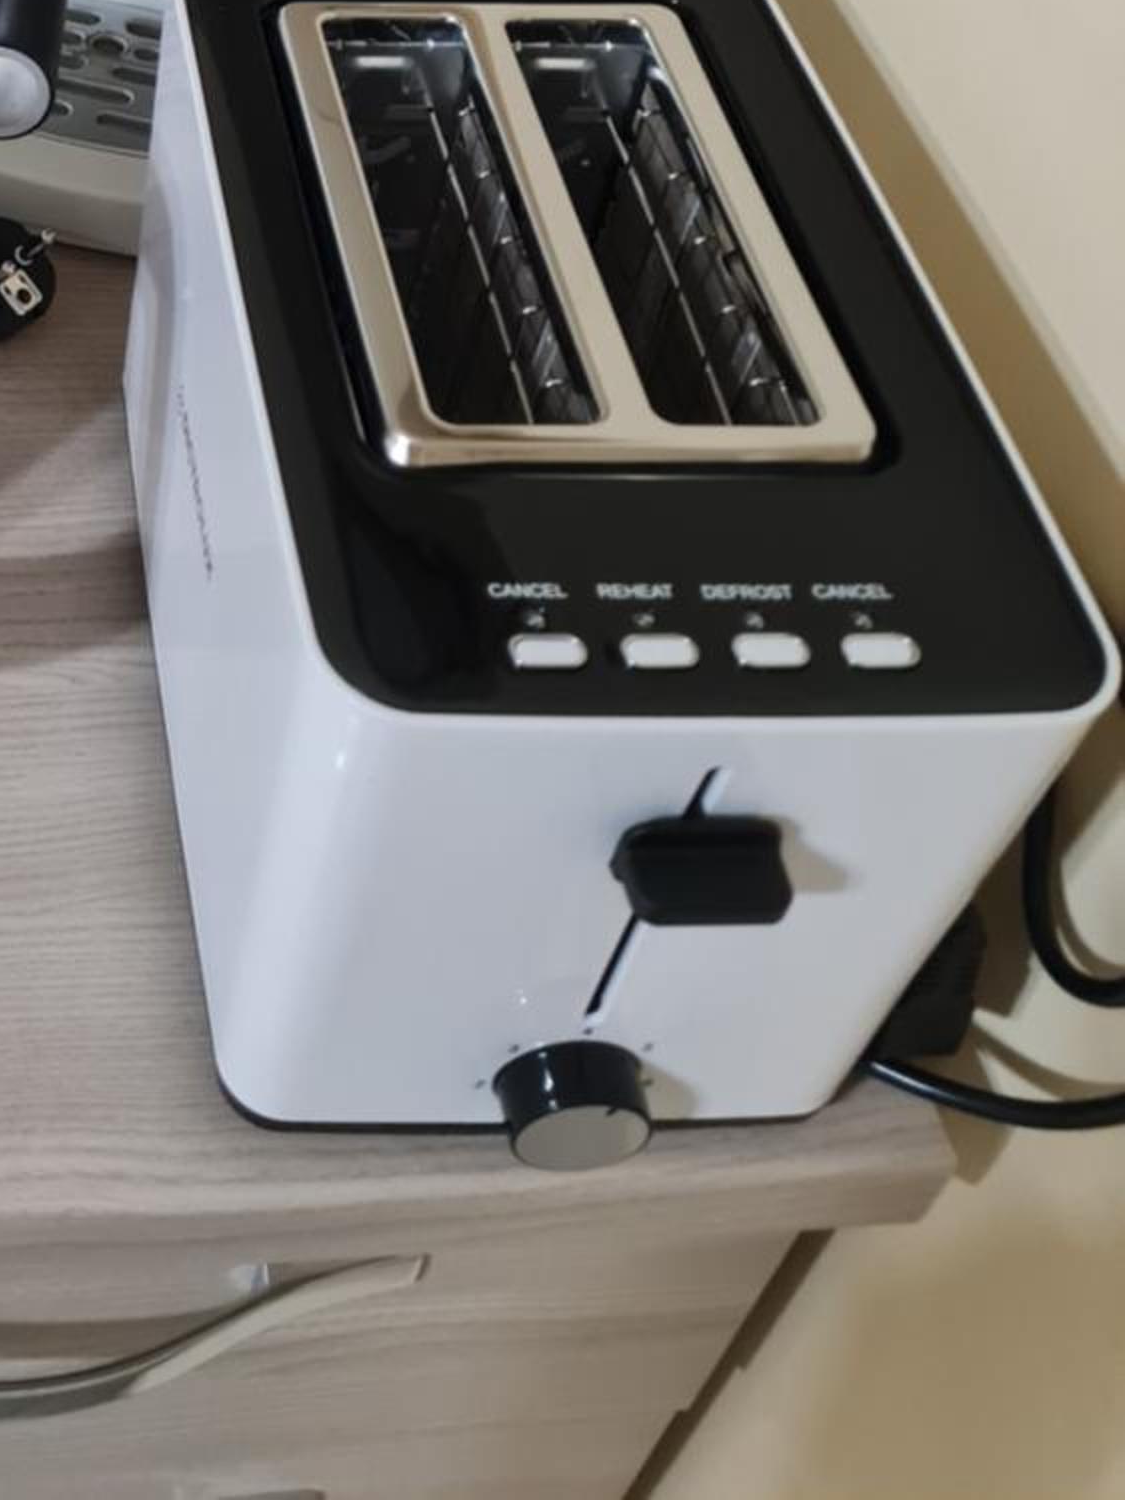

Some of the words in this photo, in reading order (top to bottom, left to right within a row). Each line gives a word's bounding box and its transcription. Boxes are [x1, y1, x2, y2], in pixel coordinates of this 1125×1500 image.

[487, 582, 569, 599] CANCEL
[596, 583, 673, 599] REHEAT
[700, 583, 791, 600] DEFROST
[811, 583, 894, 599] CANCEL
